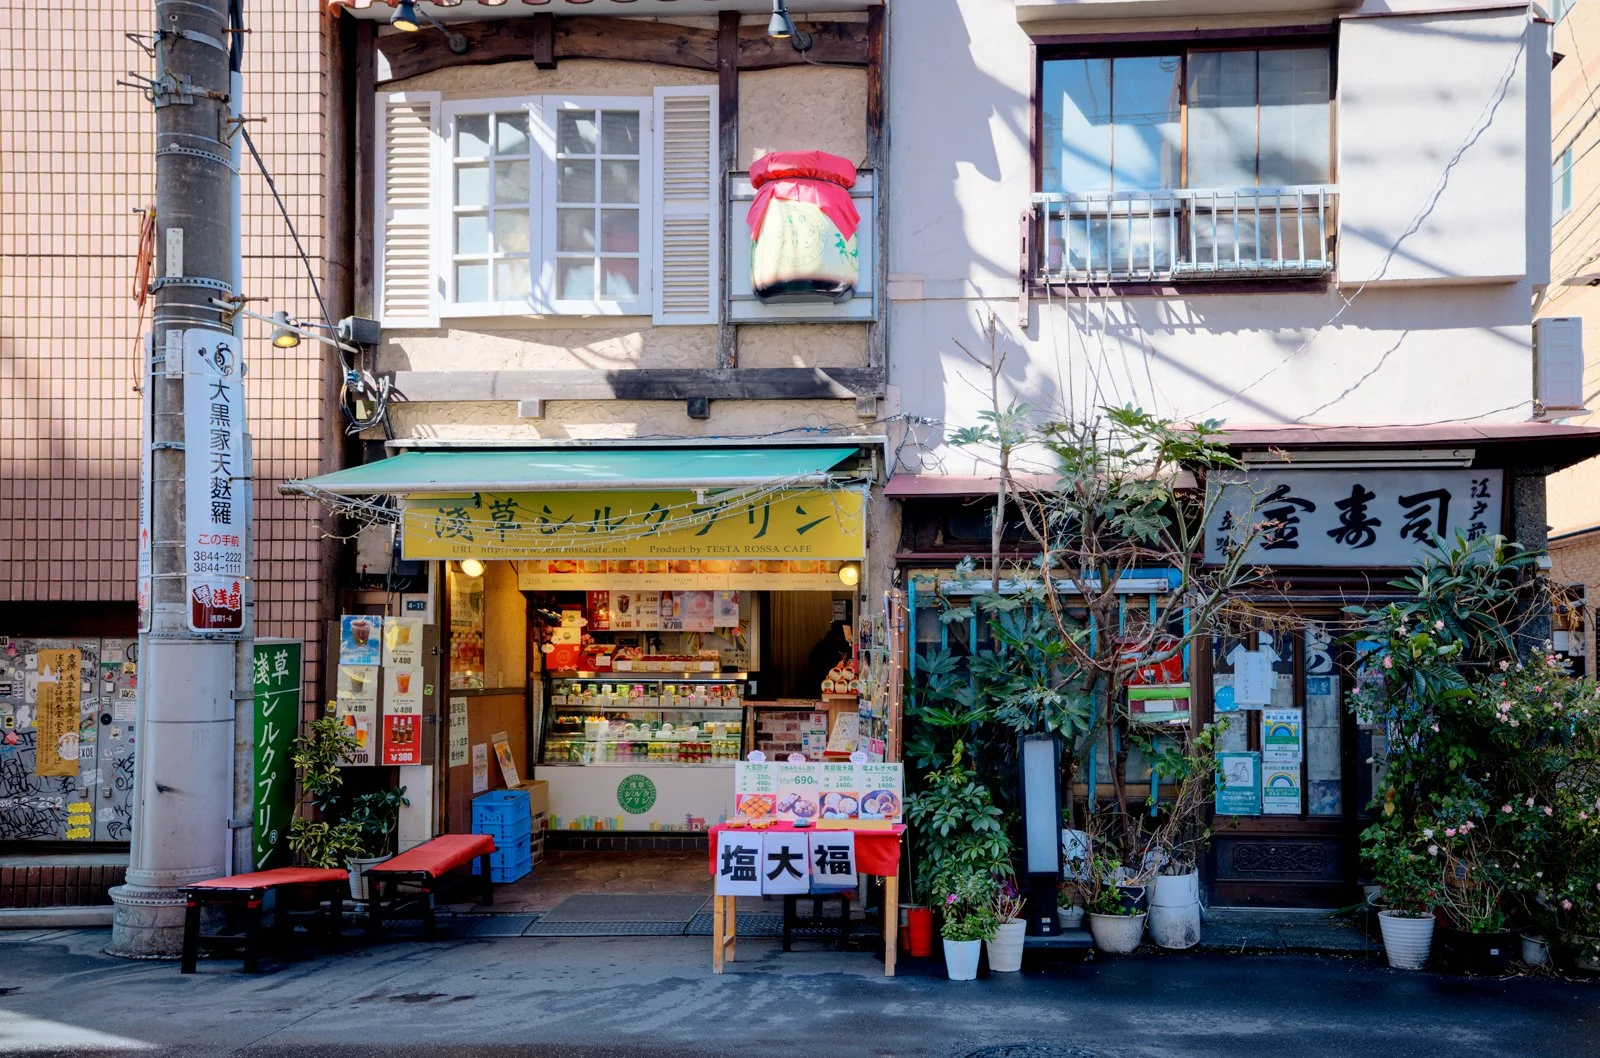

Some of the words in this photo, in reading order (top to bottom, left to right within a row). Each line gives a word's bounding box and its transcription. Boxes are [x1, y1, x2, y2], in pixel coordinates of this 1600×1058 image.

[1466, 478, 1492, 544] 江戸前
[198, 533, 240, 547] この手前
[193, 550, 242, 562] 3844-2222
[690, 546, 702, 554] by
[193, 562, 241, 574] 3844-1111
[213, 588, 240, 610] 浅草
[663, 621, 683, 629] ¥700
[257, 691, 280, 870] シルクプリン
[720, 844, 852, 882] 塩大福
